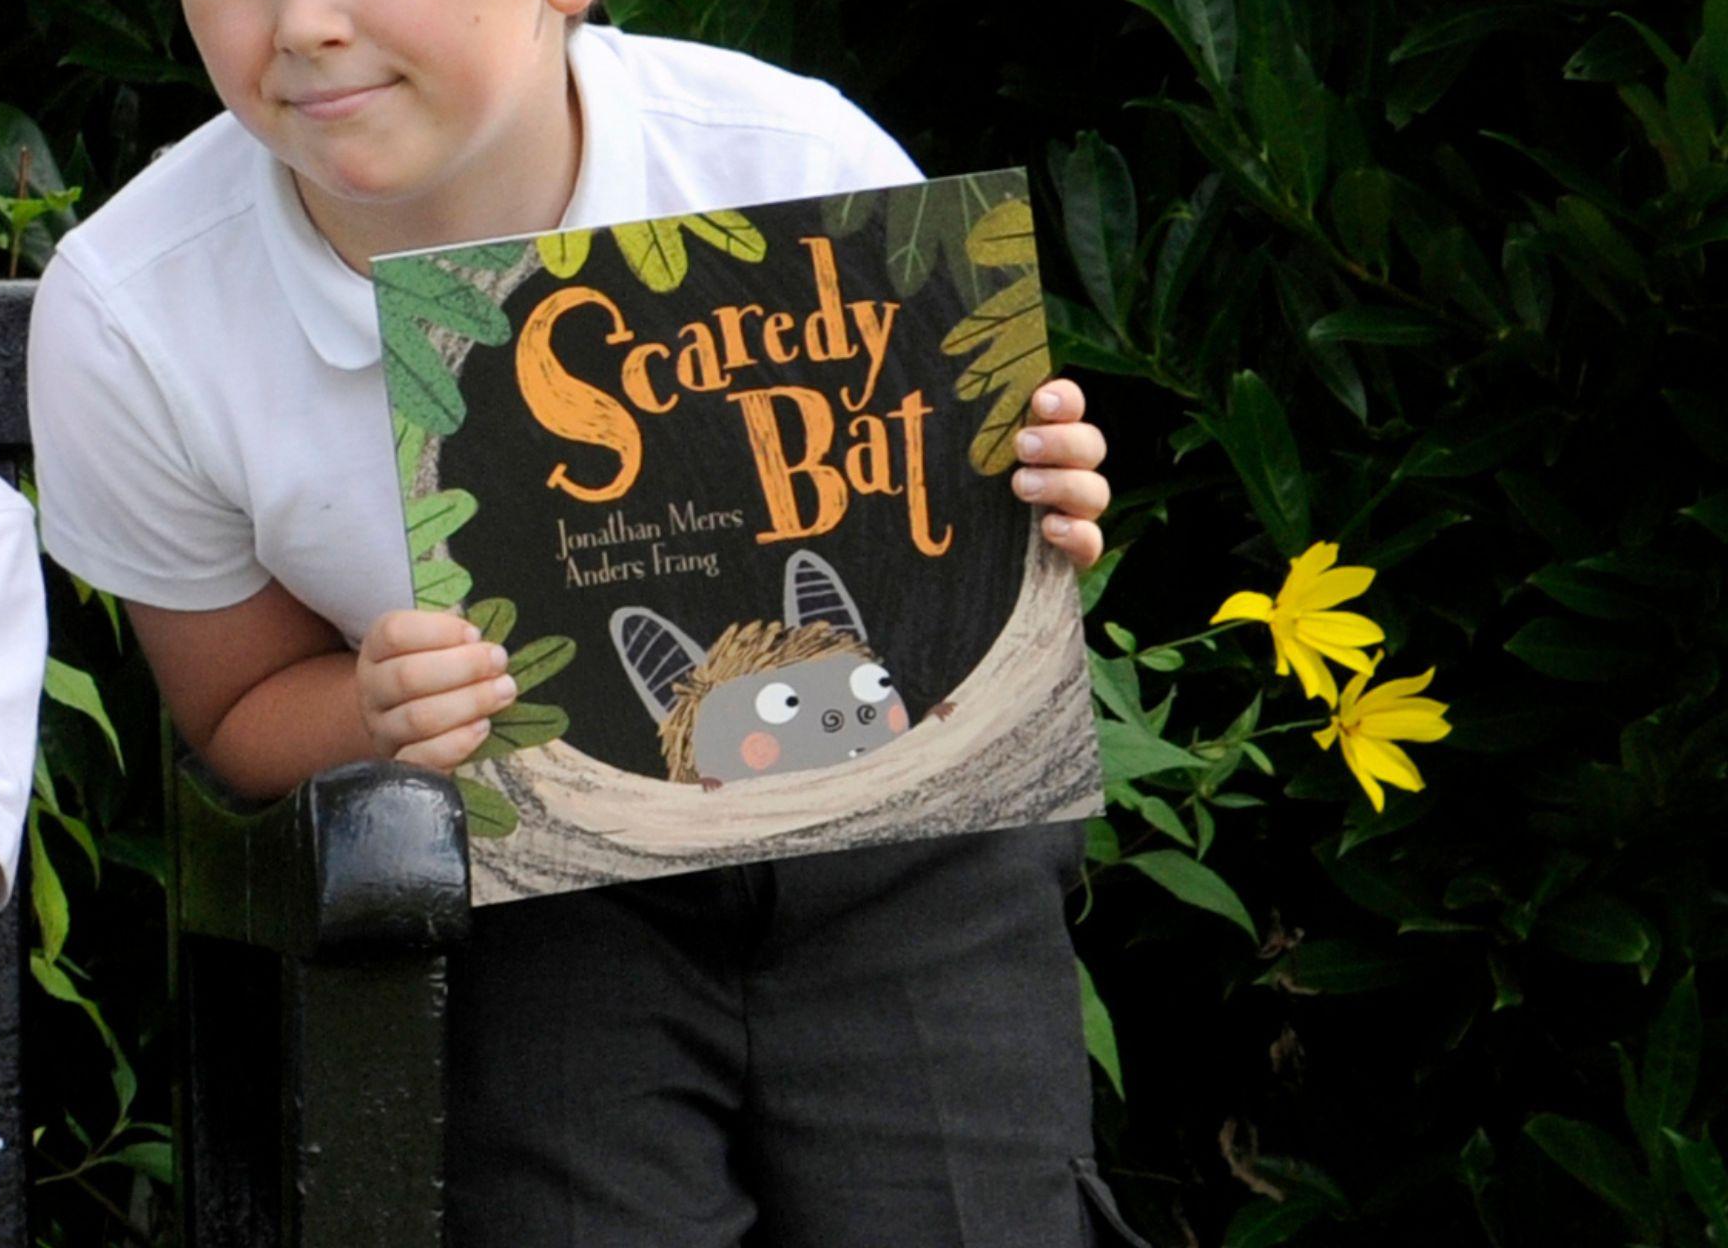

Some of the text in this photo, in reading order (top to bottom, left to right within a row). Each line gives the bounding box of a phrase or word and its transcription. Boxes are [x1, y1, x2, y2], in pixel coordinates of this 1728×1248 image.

[515, 236, 900, 503] Scaredy
[725, 385, 953, 557] Bat
[556, 501, 744, 561] Jonathan Meres
[564, 543, 721, 588] Anders Frang
